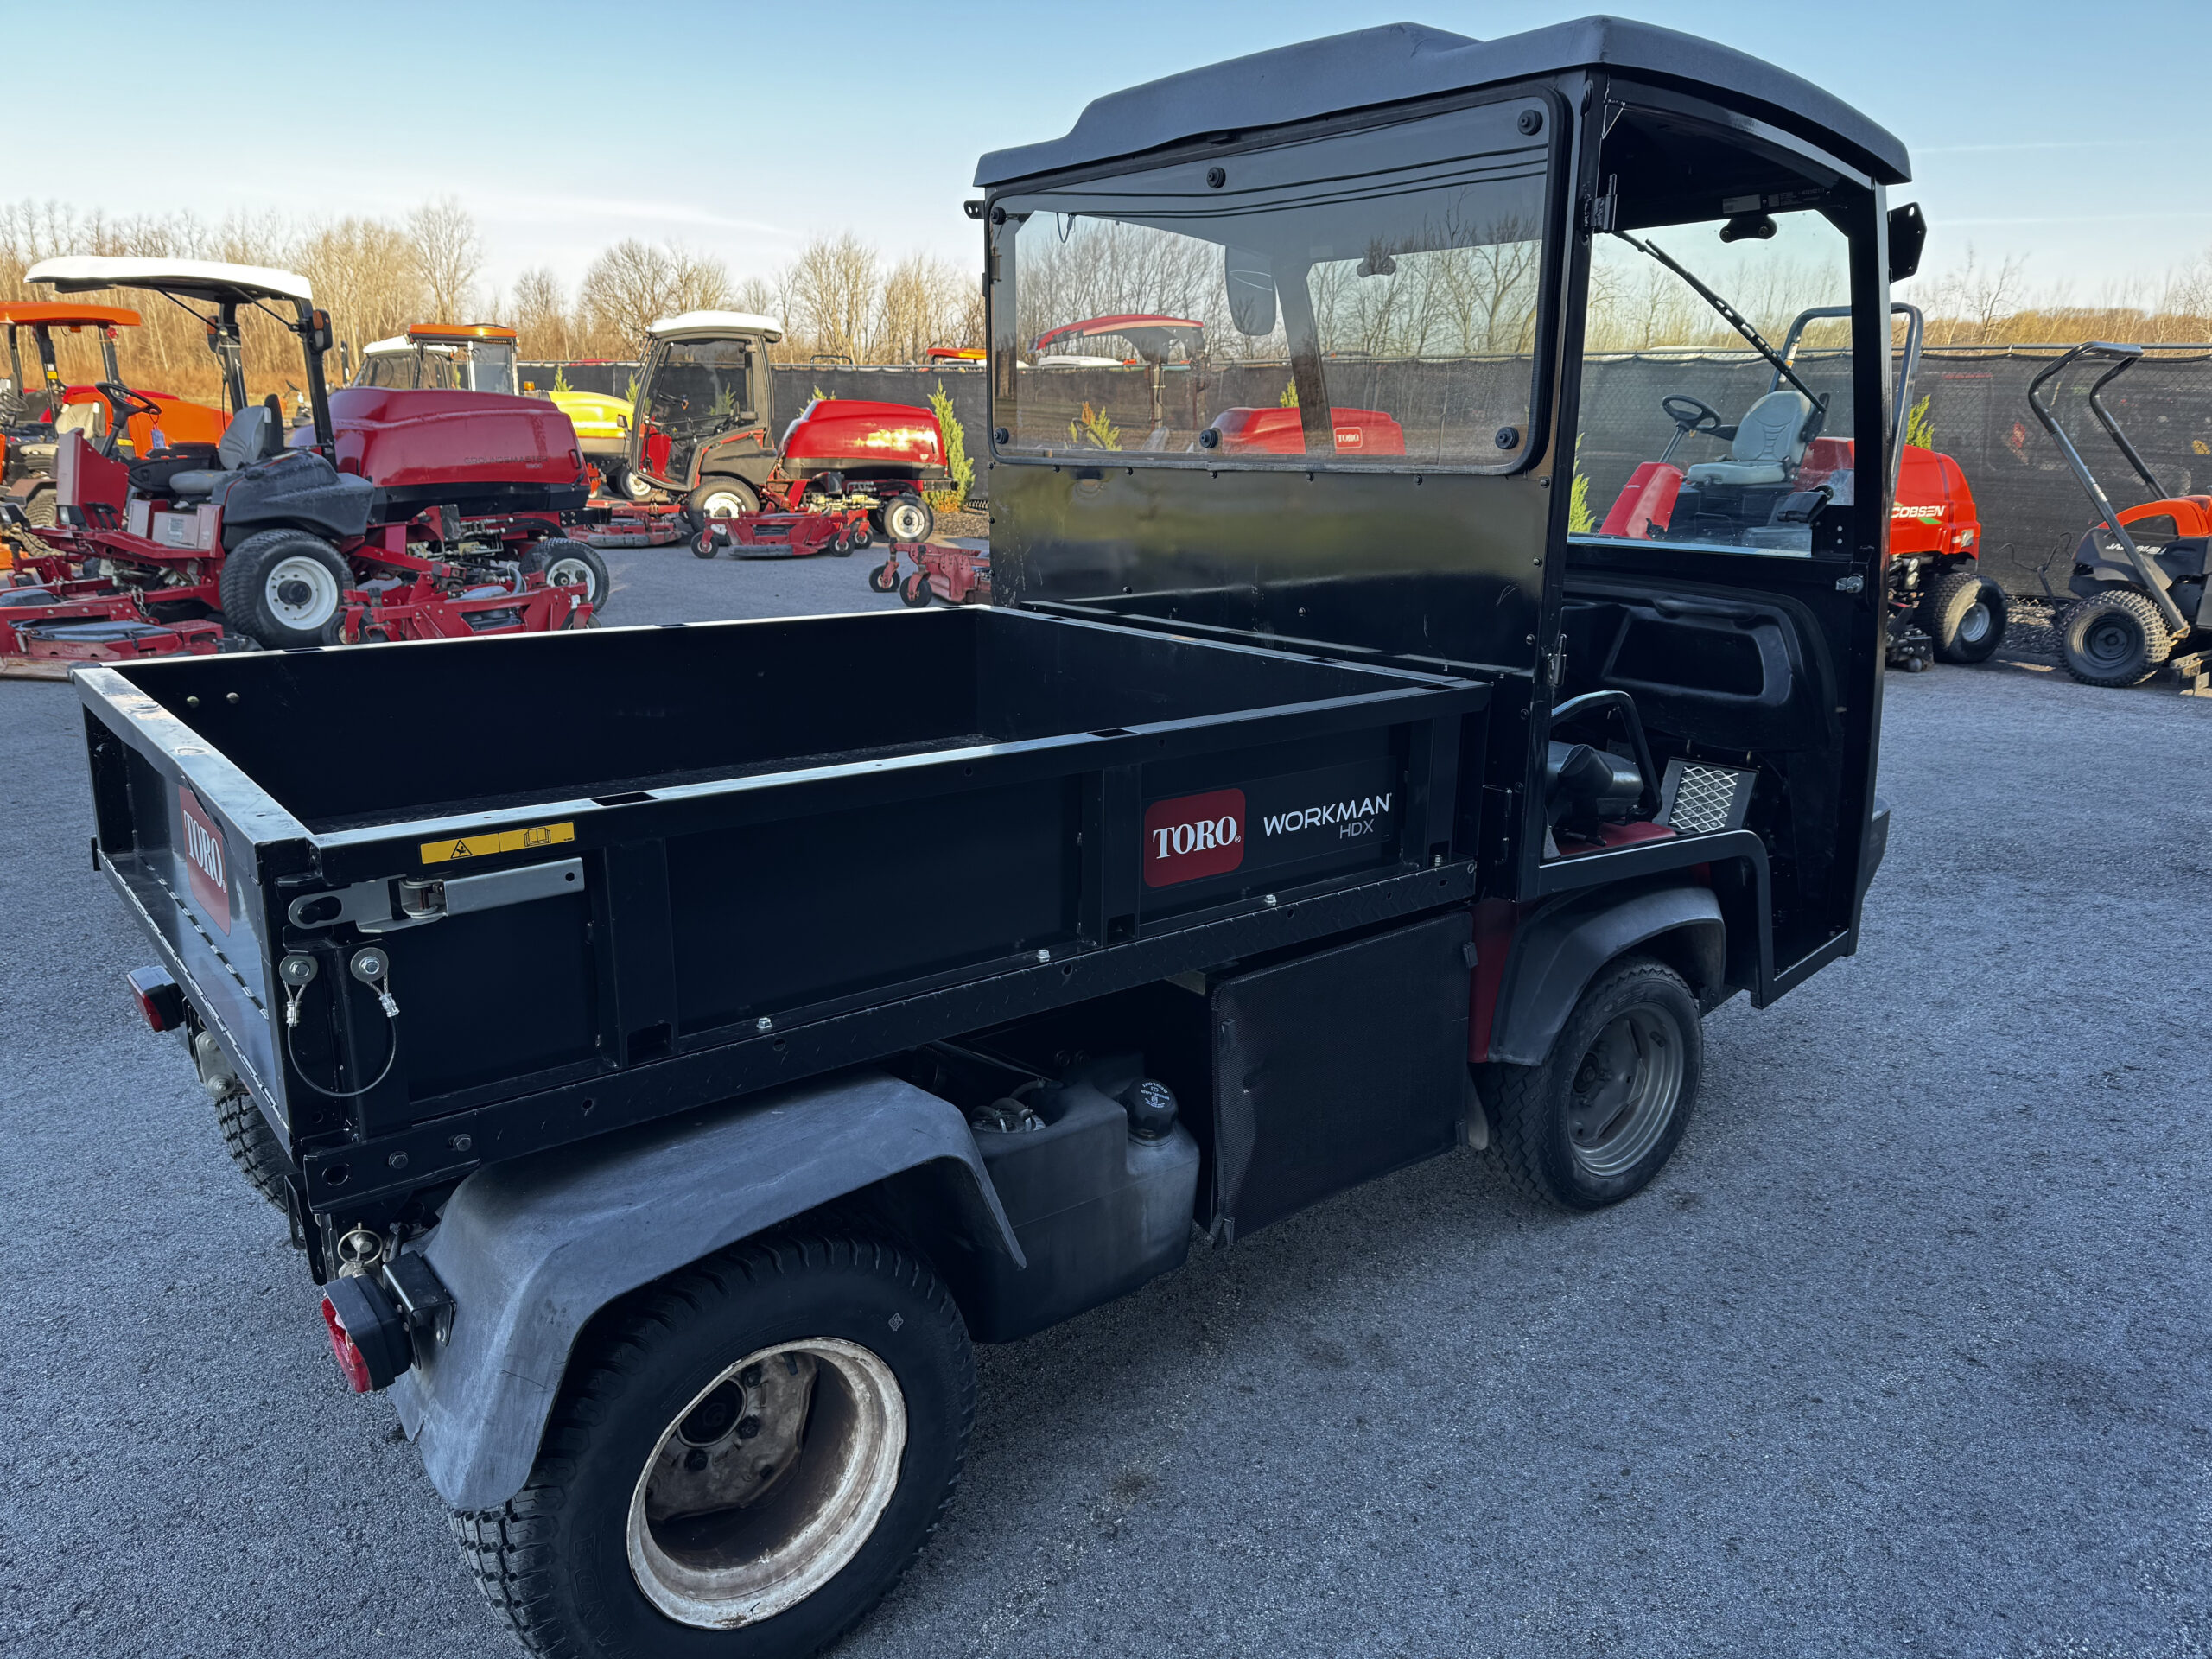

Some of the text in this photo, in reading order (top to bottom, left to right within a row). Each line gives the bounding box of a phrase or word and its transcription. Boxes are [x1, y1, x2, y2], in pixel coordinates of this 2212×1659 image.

[1337, 434, 1359, 443] TORO
[464, 455, 549, 465] GROUNDSMASTER
[1262, 792, 1392, 837] WORKMAN
[1339, 818, 1376, 840] HDX
[183, 810, 223, 888] TORO
[1153, 816, 1238, 860] TORO
